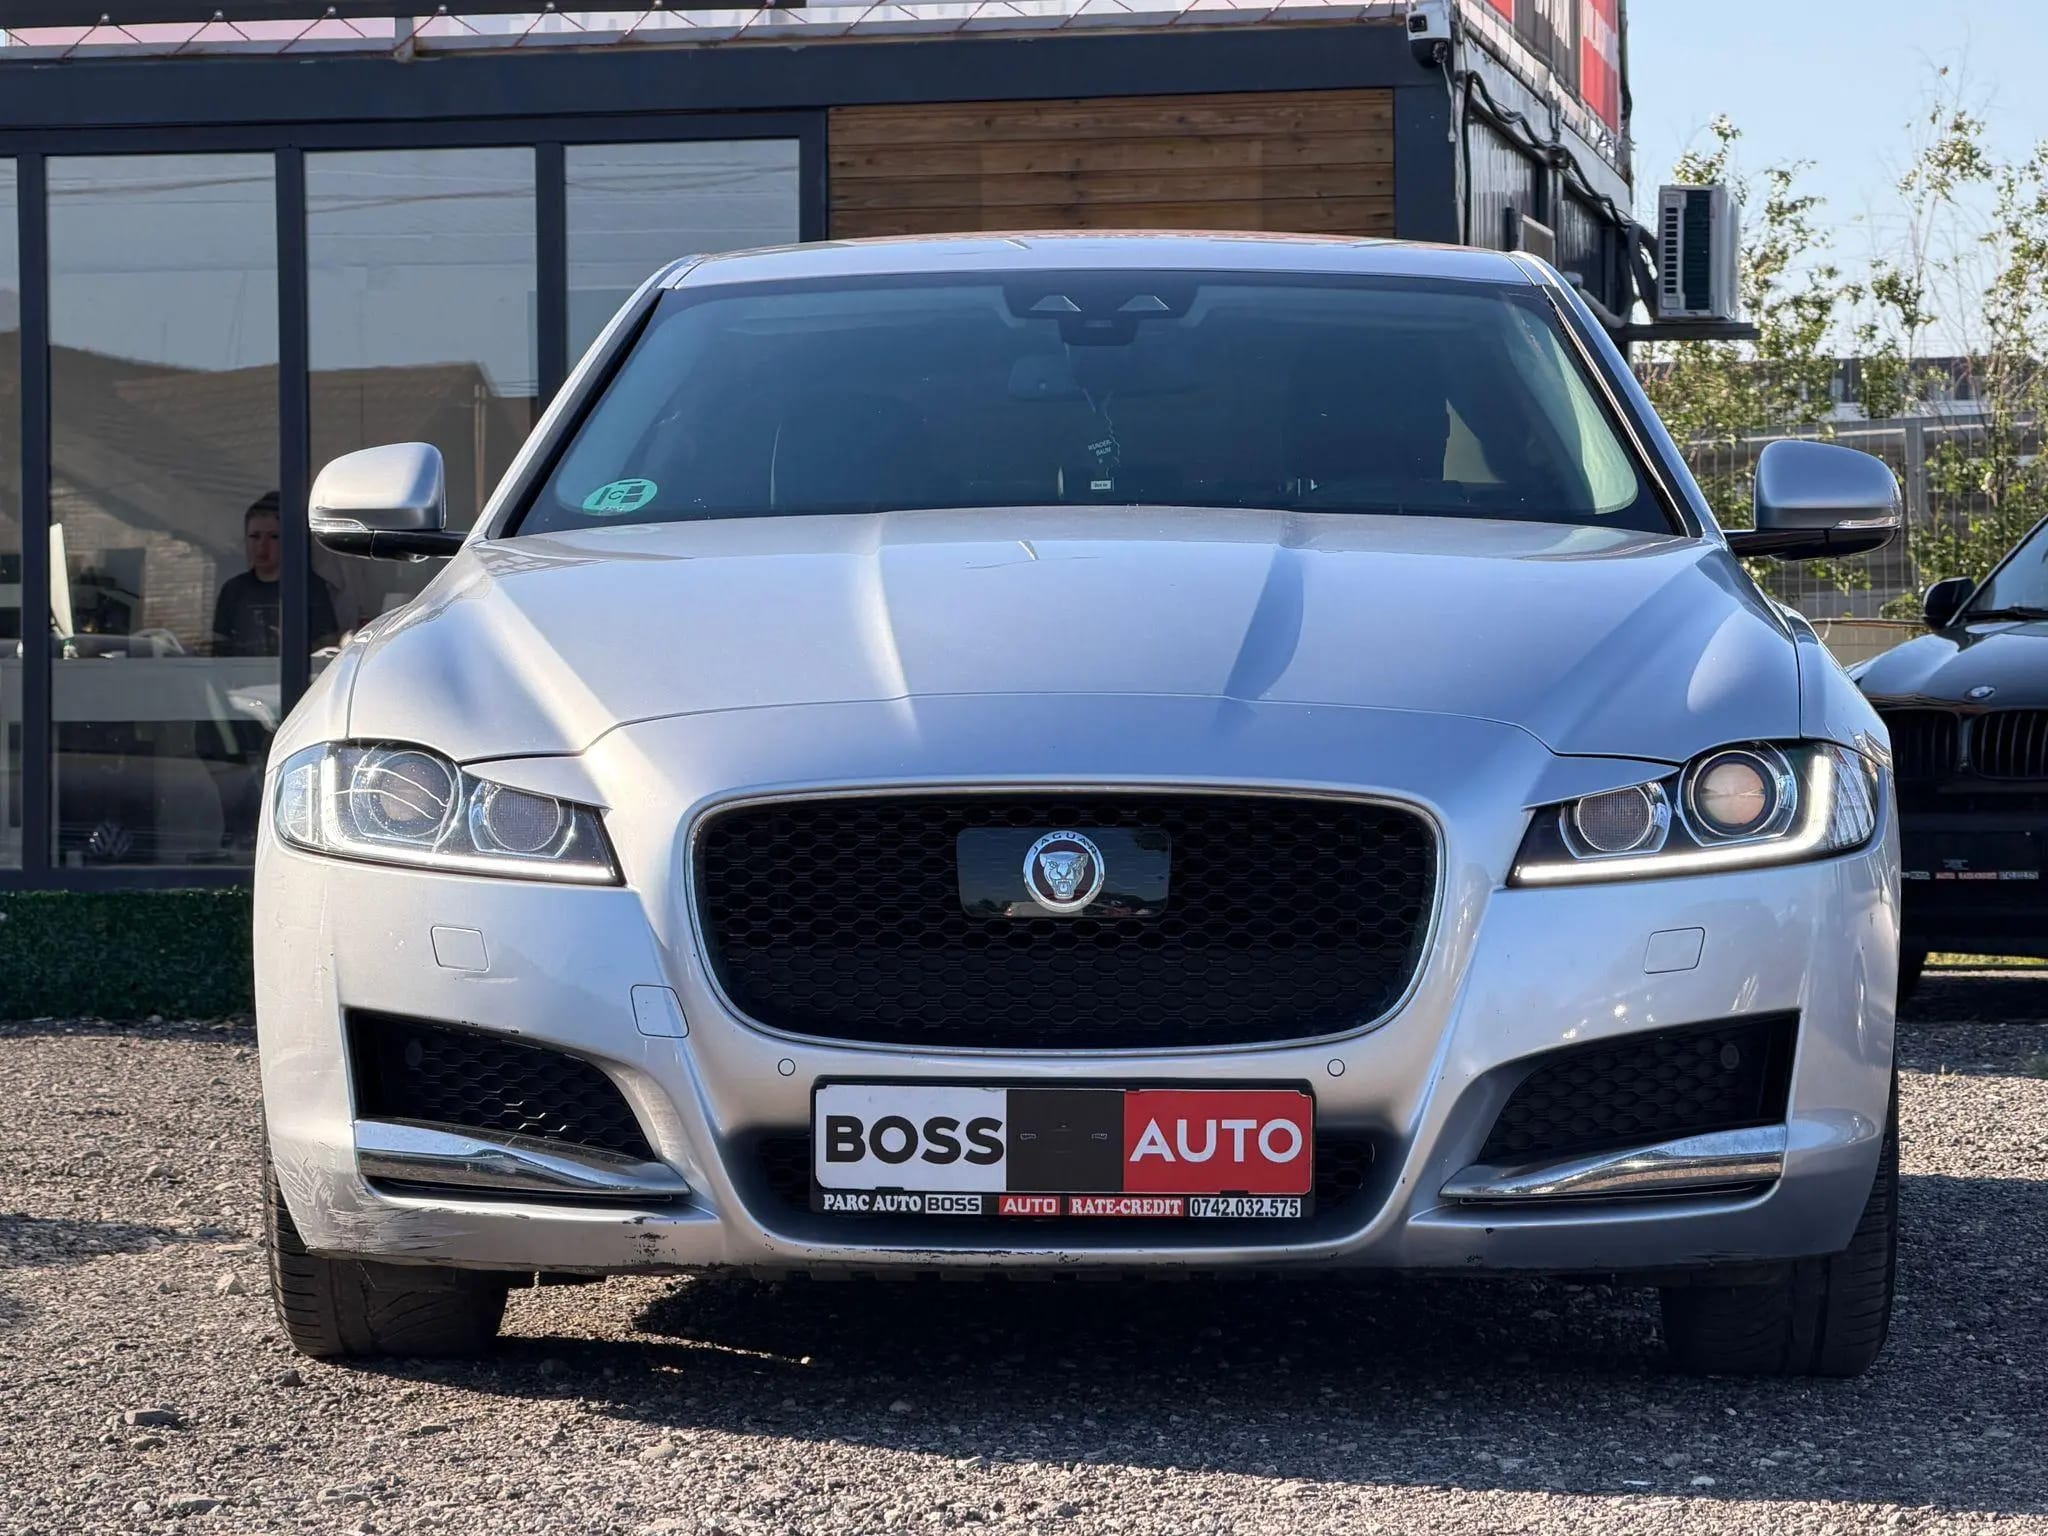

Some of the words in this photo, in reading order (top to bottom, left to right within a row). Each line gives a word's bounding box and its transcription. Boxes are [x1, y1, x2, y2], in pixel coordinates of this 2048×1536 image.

[1033, 831, 1098, 855] JAGUAR
[825, 1114, 1005, 1166] BOSS
[1129, 1117, 1303, 1164] AUTO
[823, 1194, 869, 1212] PARC
[872, 1195, 922, 1212] AUTO
[927, 1196, 981, 1214] BOSS
[1003, 1198, 1057, 1214] AUTO
[1071, 1198, 1182, 1215] RATE-CREDIT
[1191, 1199, 1299, 1217] 0742.032.575
